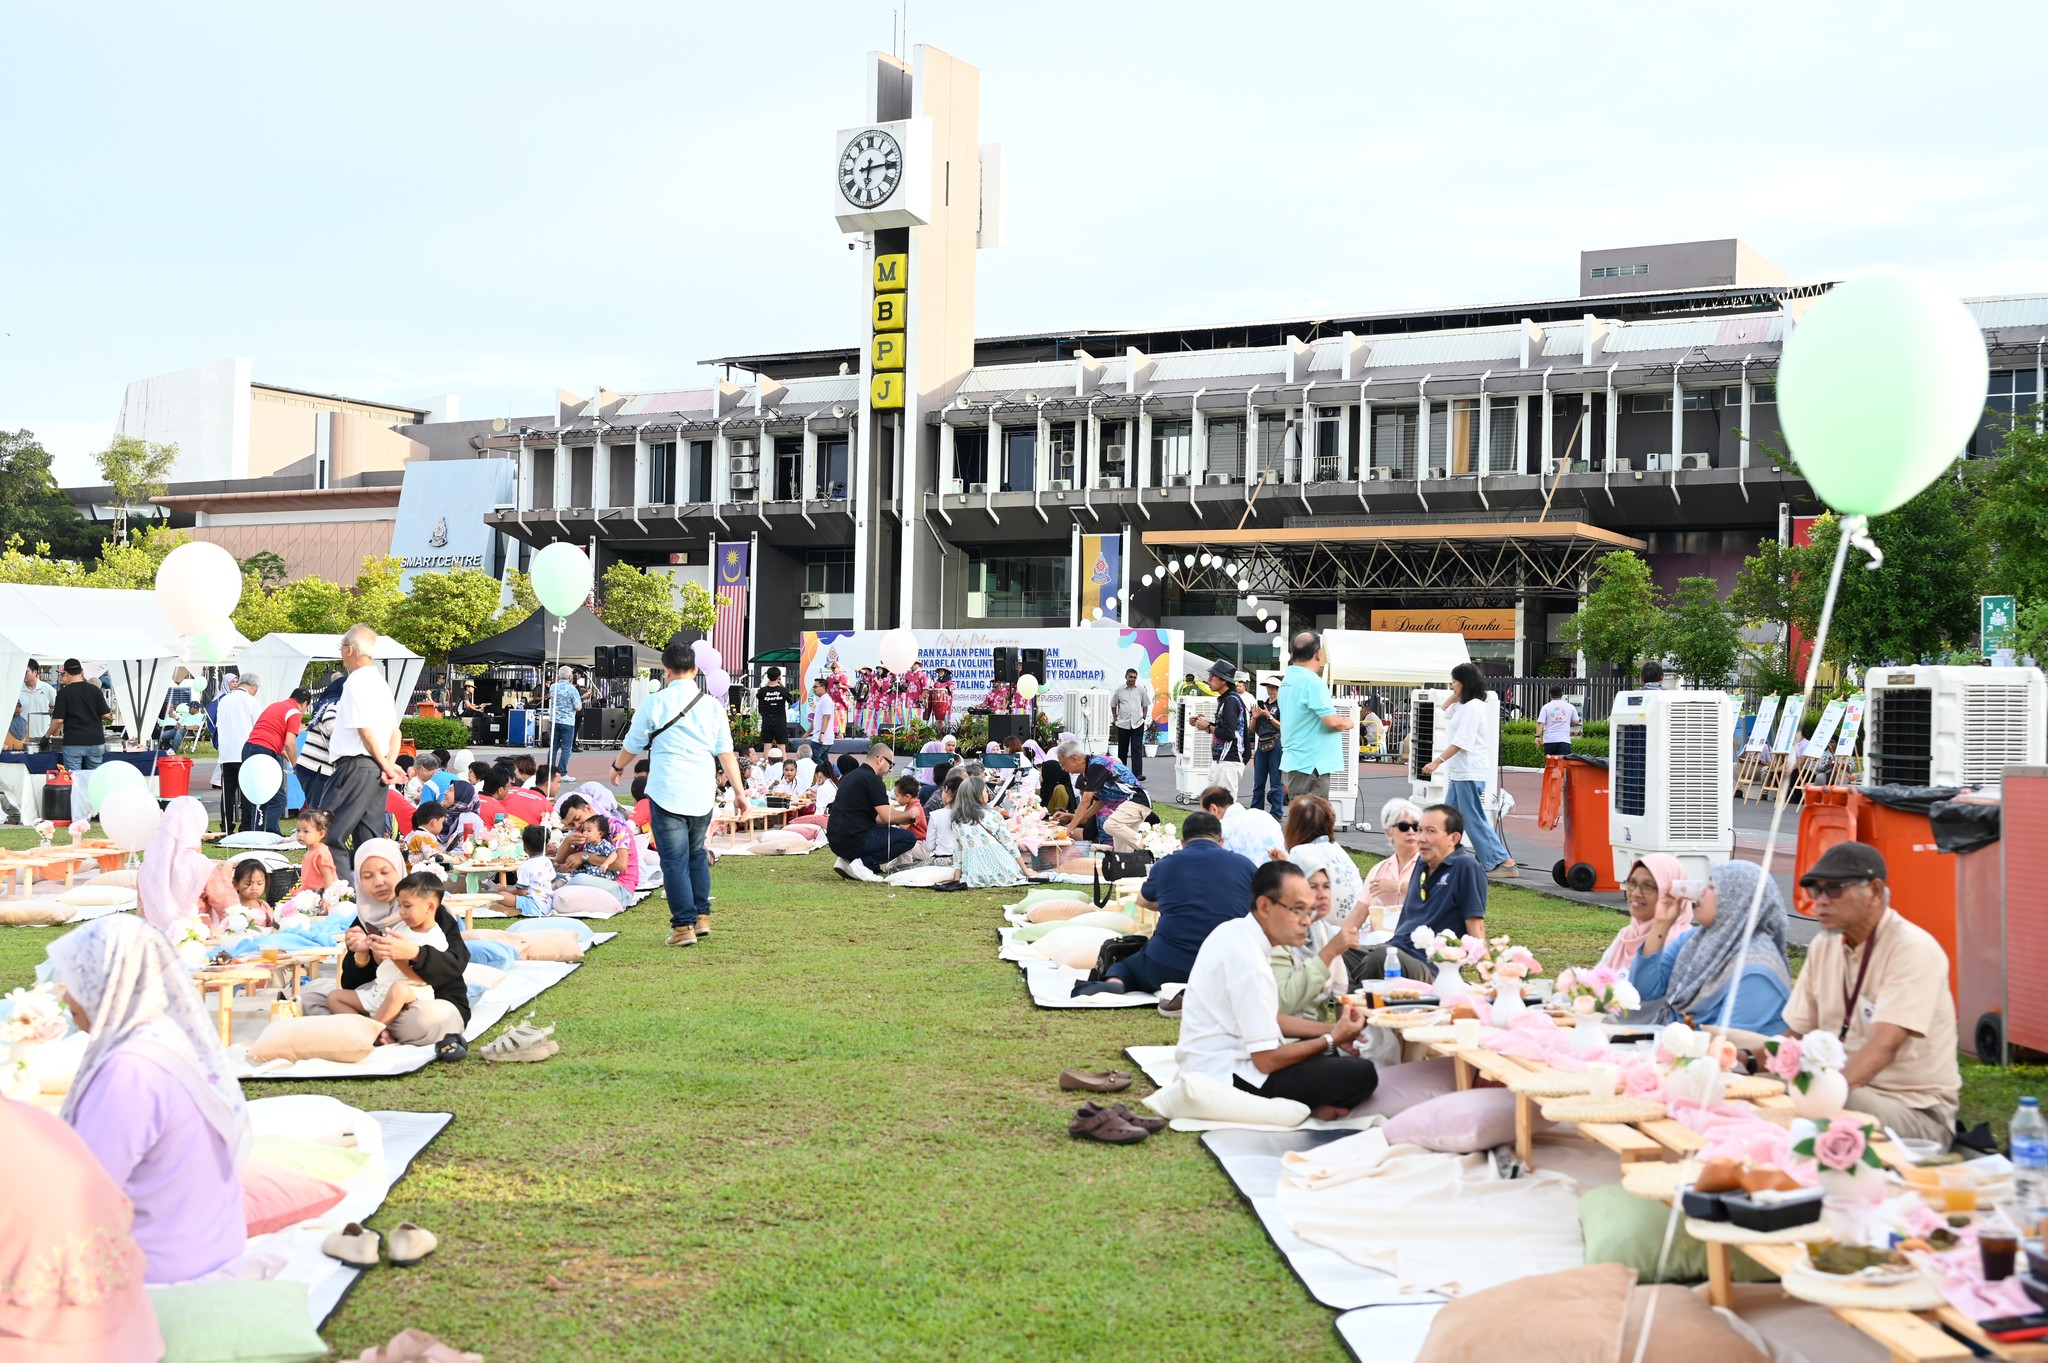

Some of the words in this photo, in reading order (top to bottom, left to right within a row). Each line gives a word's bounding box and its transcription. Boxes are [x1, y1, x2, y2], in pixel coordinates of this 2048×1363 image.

[400, 554, 482, 567] SMARTCENTRE
[1394, 615, 1442, 631] Daulat
[1445, 614, 1502, 632] Tuanku
[936, 648, 967, 657] KAJIAN
[969, 648, 993, 657] PENIL
[957, 659, 994, 669] (VOLUNT
[1046, 659, 1077, 669] EVIEW)
[1059, 670, 1105, 680] ROADMAP)
[953, 680, 985, 689] TALING
